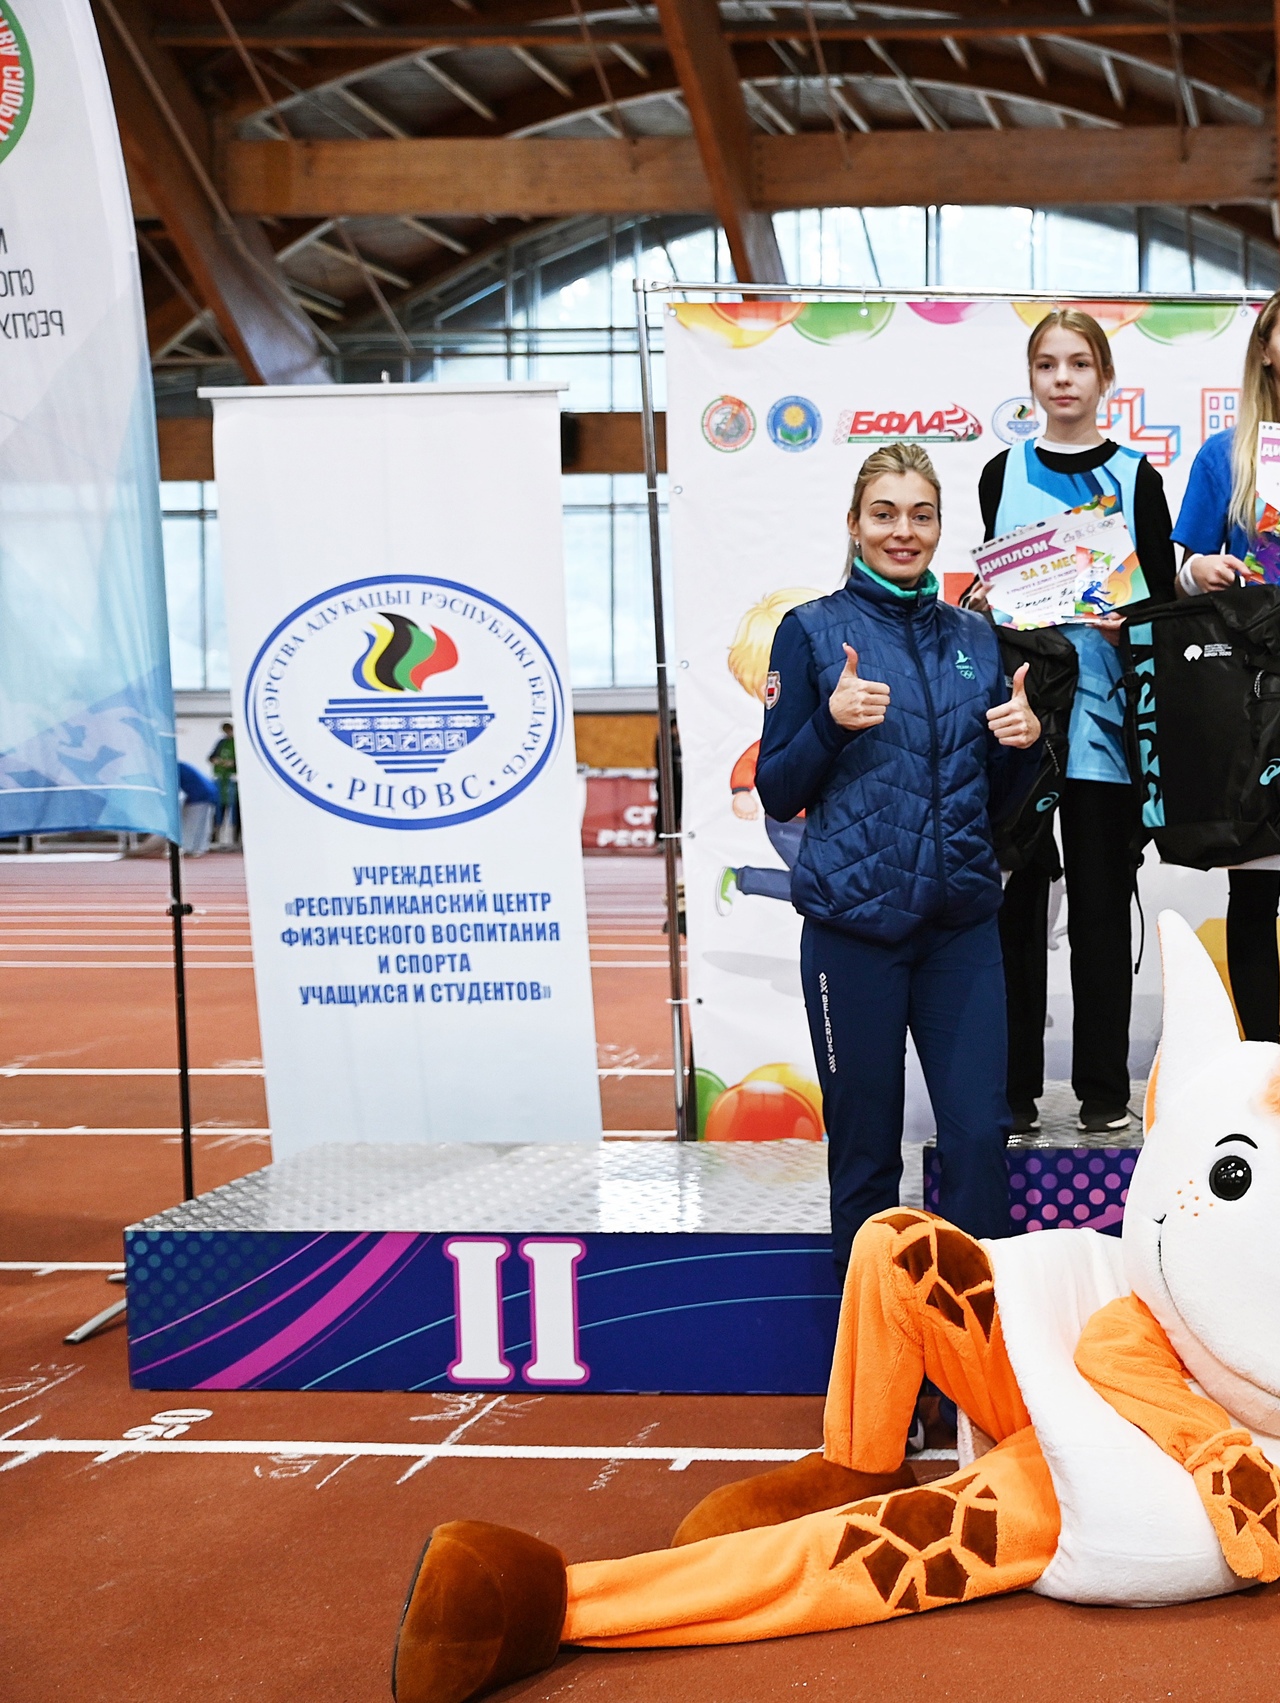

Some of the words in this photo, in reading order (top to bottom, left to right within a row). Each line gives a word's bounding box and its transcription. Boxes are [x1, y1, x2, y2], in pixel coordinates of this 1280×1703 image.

[850, 410, 945, 435] БФЛА
[980, 540, 1049, 575] ДИПЛОМ
[1020, 567, 1039, 581] ЗА
[1041, 564, 1050, 575] 2
[264, 634, 319, 784] МІНІСТЭРСТВА
[306, 590, 412, 637] АДУКАЦЫІ
[420, 590, 536, 669] РЭСПУБЛІКІ
[502, 675, 547, 777] БЕЛАРУСЬ
[347, 774, 483, 814] РЦФВС
[353, 863, 482, 888] УЧРЕЖДЕНИЕ
[285, 889, 487, 917] «РЕСПУБЛИКАНСКИЙ
[493, 892, 552, 916] ЦЕНТР
[281, 924, 426, 947] ФИЗИЧЕСКОГО
[432, 922, 561, 945] ВОСПИТАНИЯ
[378, 954, 390, 974] И
[396, 952, 472, 974] СПОРТА
[300, 983, 408, 1007] УЧАЩИХСЯ
[414, 983, 425, 1003] И
[431, 981, 551, 1004] СТУДЕНТОВ»
[821, 994, 834, 1053] BELARUS
[444, 1238, 588, 1382] II
